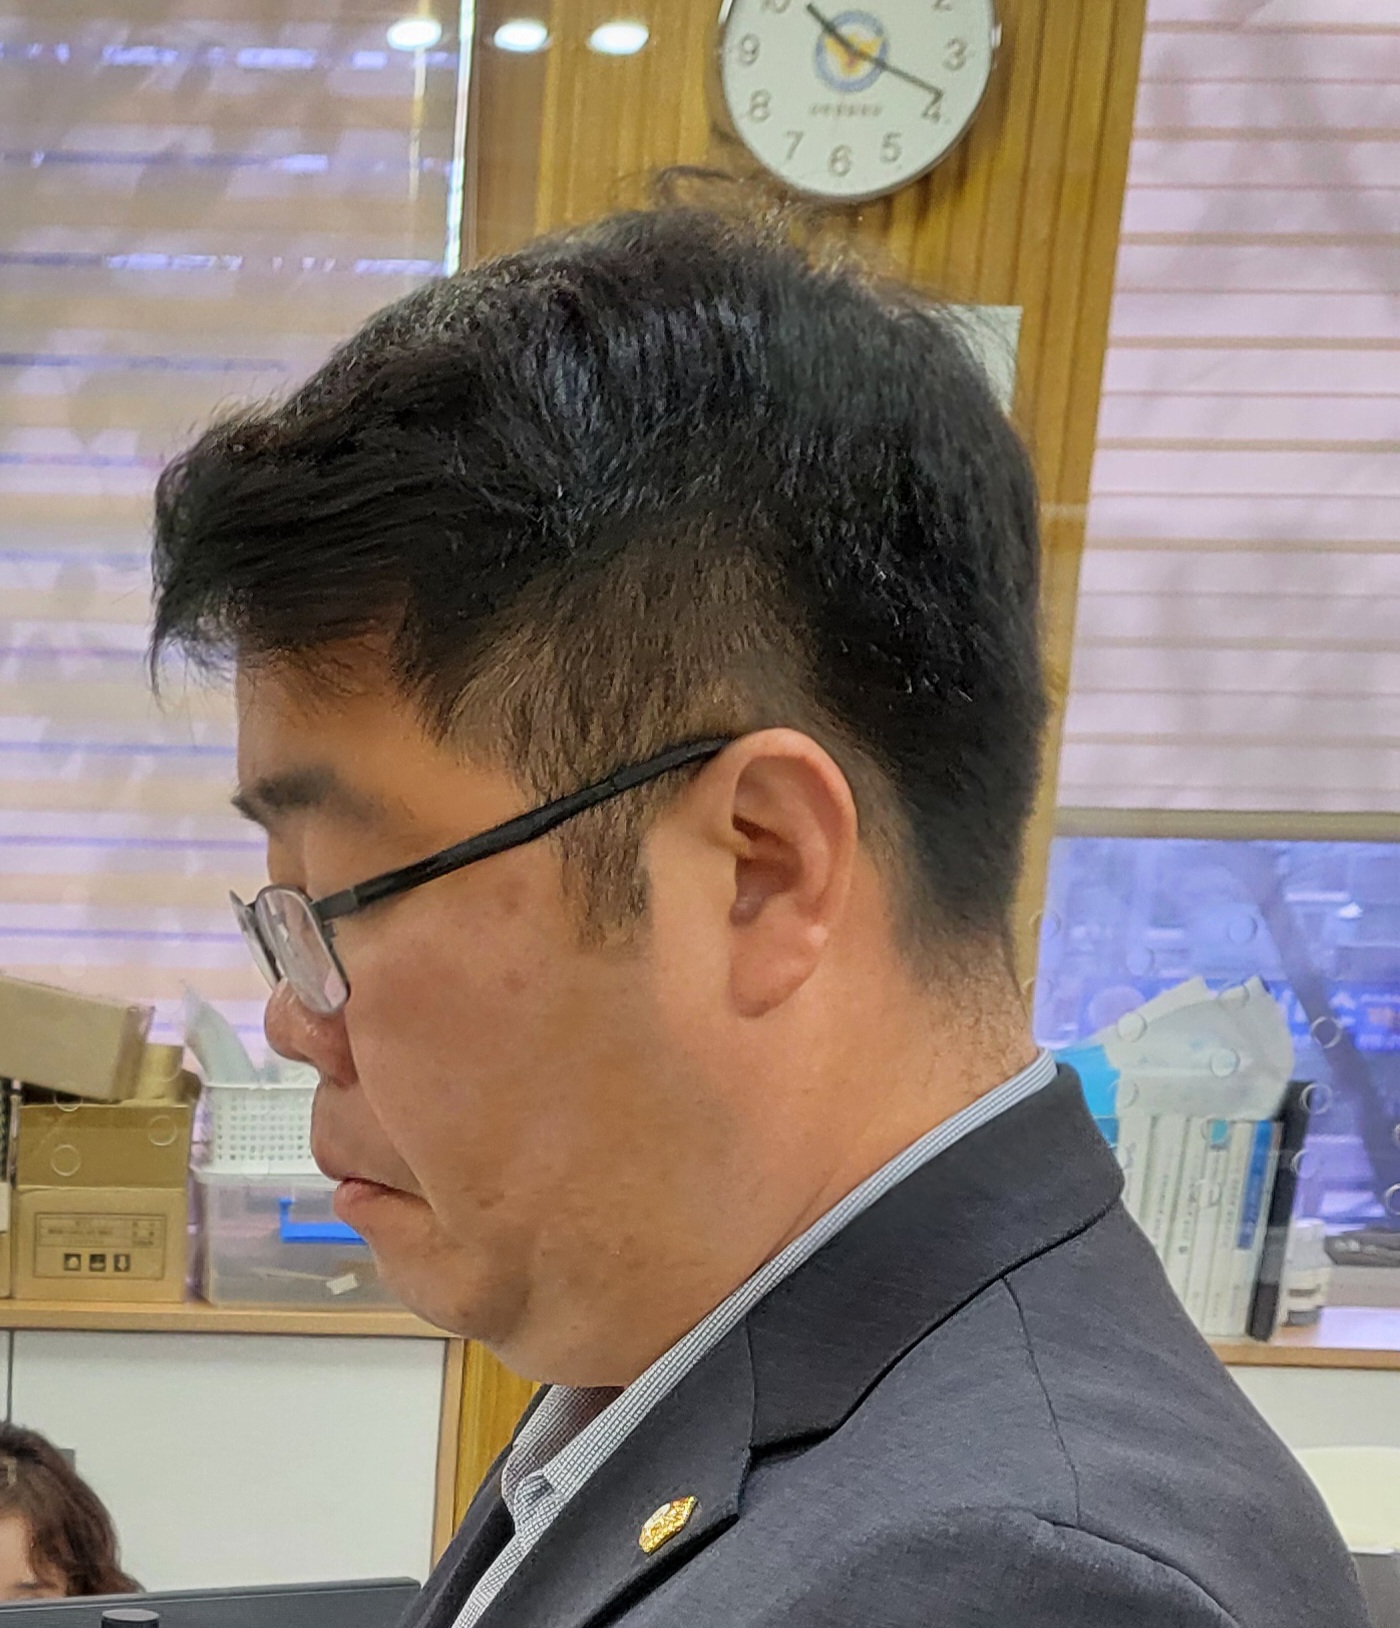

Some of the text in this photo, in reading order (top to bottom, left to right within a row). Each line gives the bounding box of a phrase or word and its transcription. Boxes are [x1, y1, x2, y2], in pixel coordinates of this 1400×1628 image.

[738, 33, 760, 66] 9
[942, 38, 967, 71] 3
[749, 89, 772, 122] 8
[784, 131, 805, 161] 7
[827, 145, 852, 177] 6
[879, 132, 903, 164] 5
